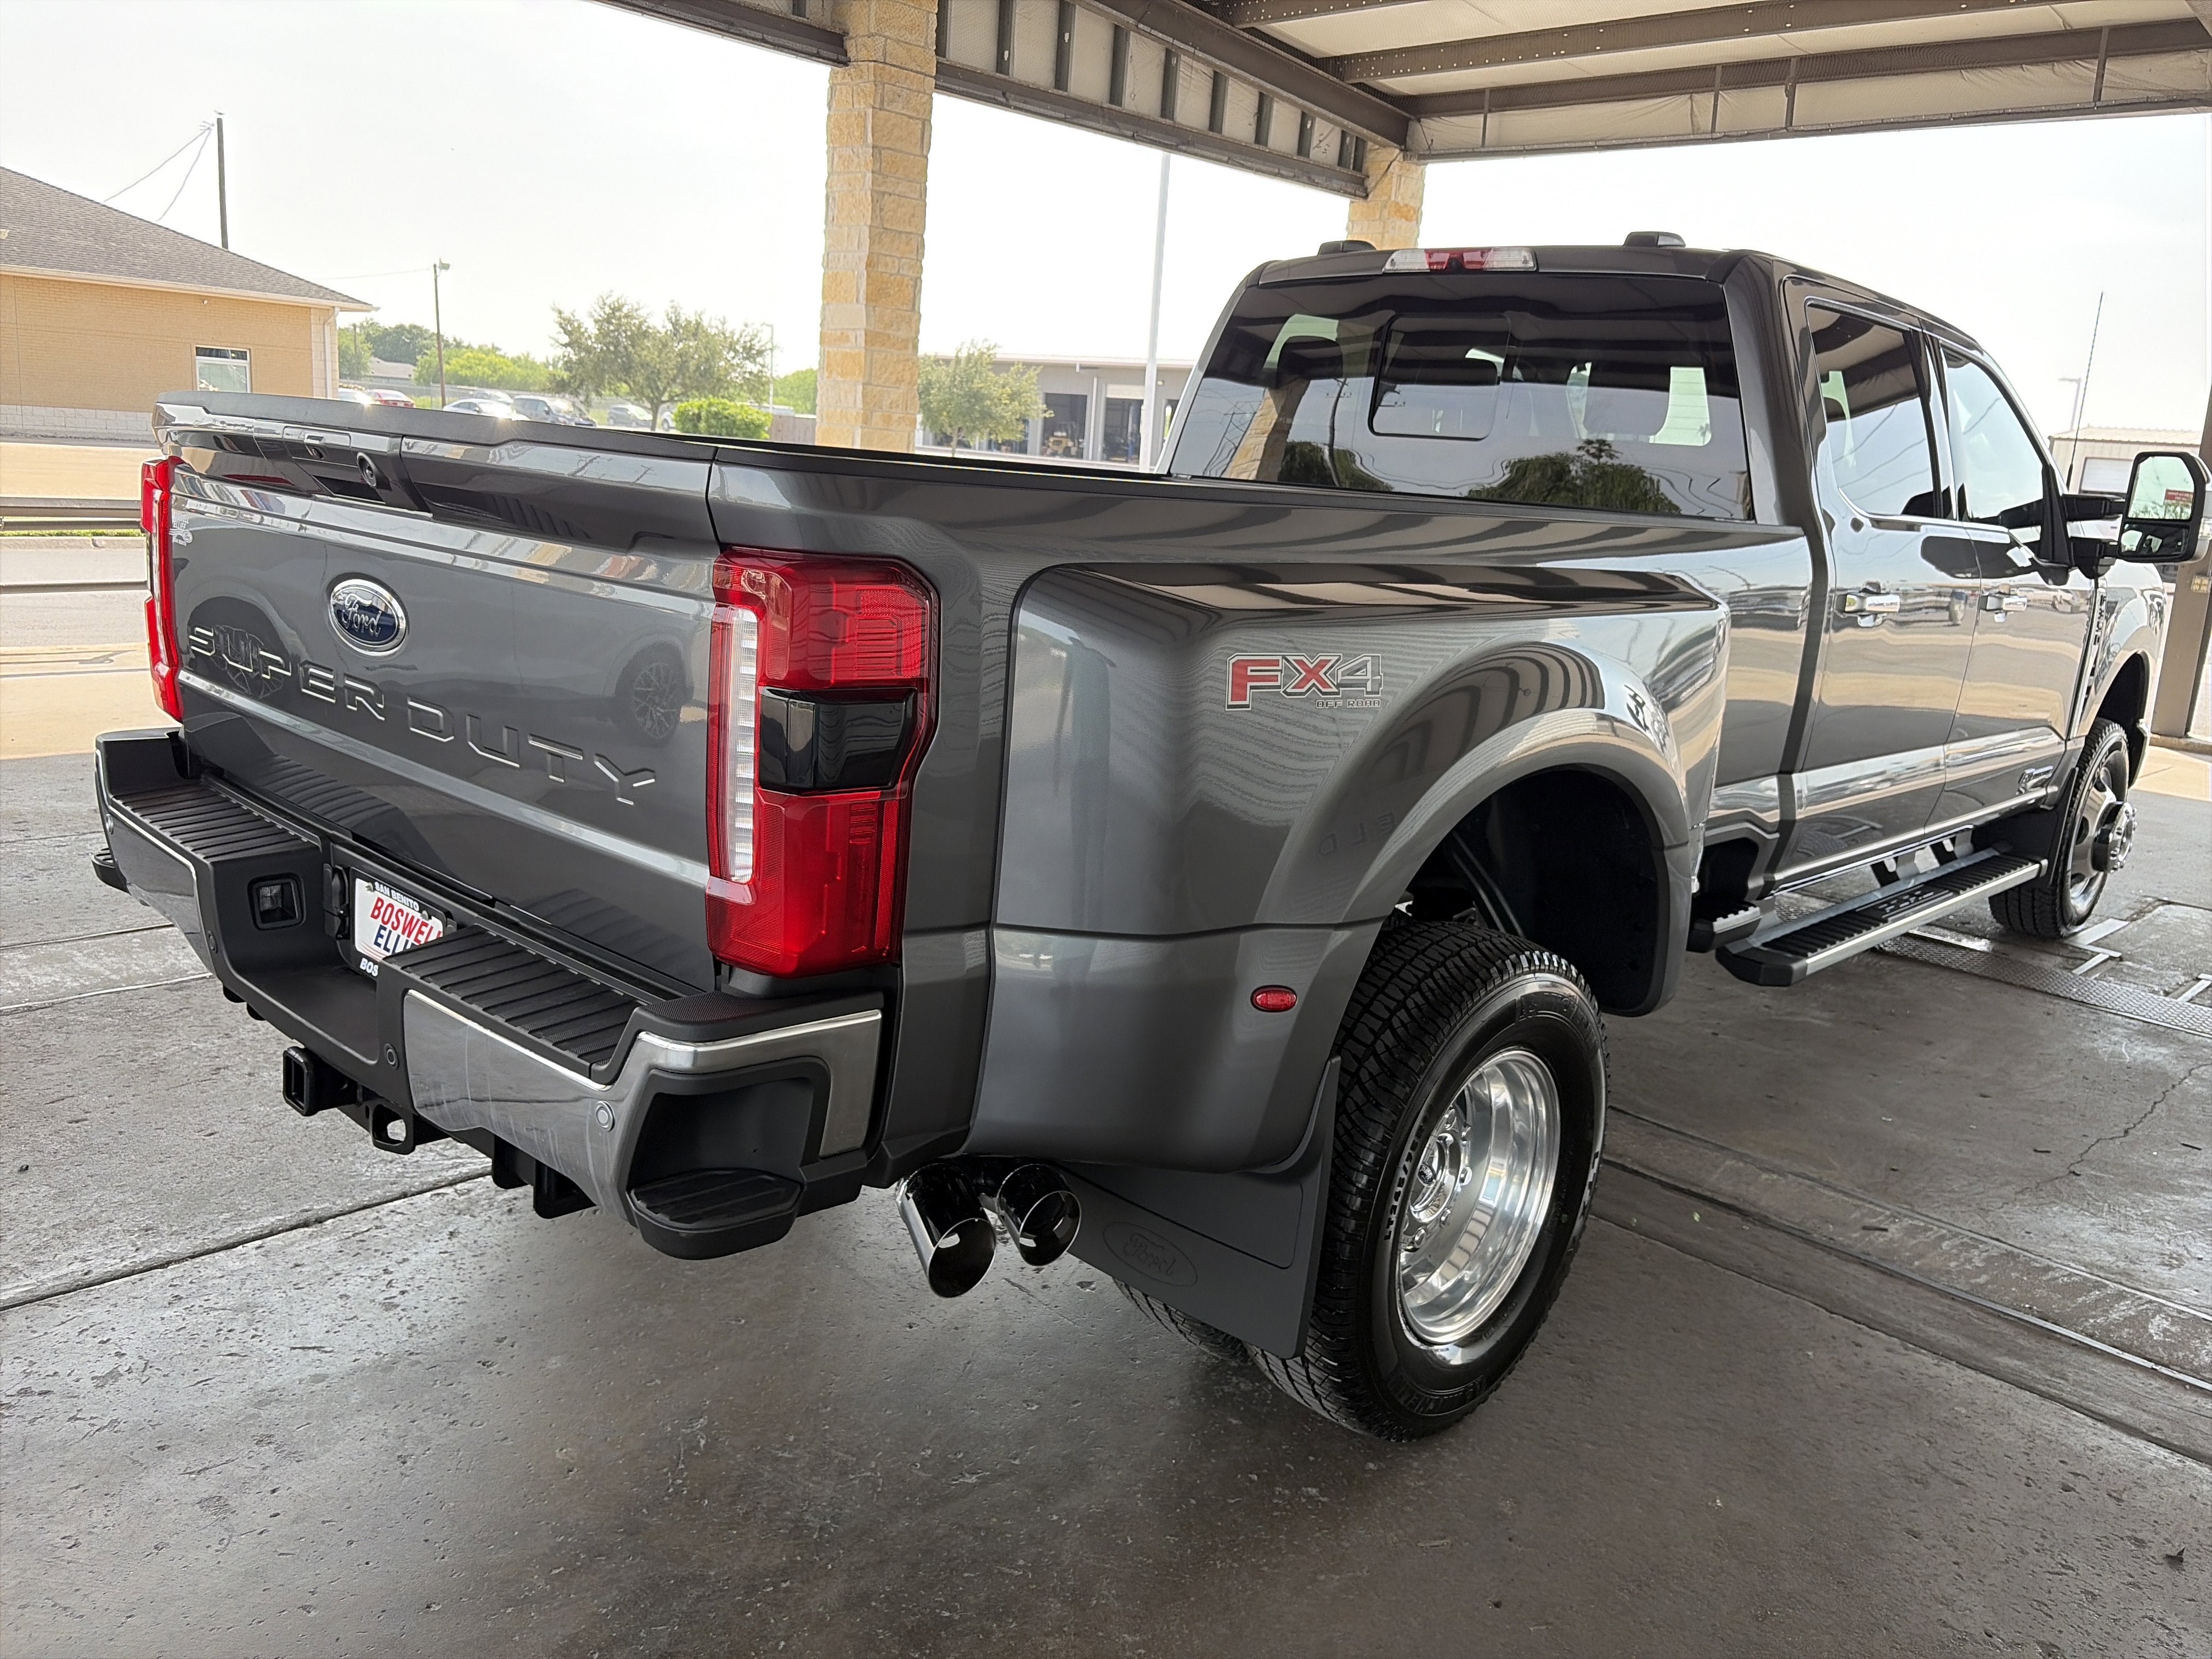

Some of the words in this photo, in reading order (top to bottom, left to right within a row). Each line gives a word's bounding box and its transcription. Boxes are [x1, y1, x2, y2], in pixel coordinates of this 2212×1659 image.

[341, 593, 382, 637] Ford
[1225, 652, 1383, 711] FX4
[1316, 698, 1342, 708] OFF
[1346, 698, 1381, 708] ROAD
[188, 625, 386, 721] SUPER
[407, 696, 656, 805] DUTY
[374, 881, 390, 897] SAN
[390, 888, 420, 911] BENITO
[370, 896, 443, 946] BOSWEL
[1124, 1233, 1177, 1276] Ford
